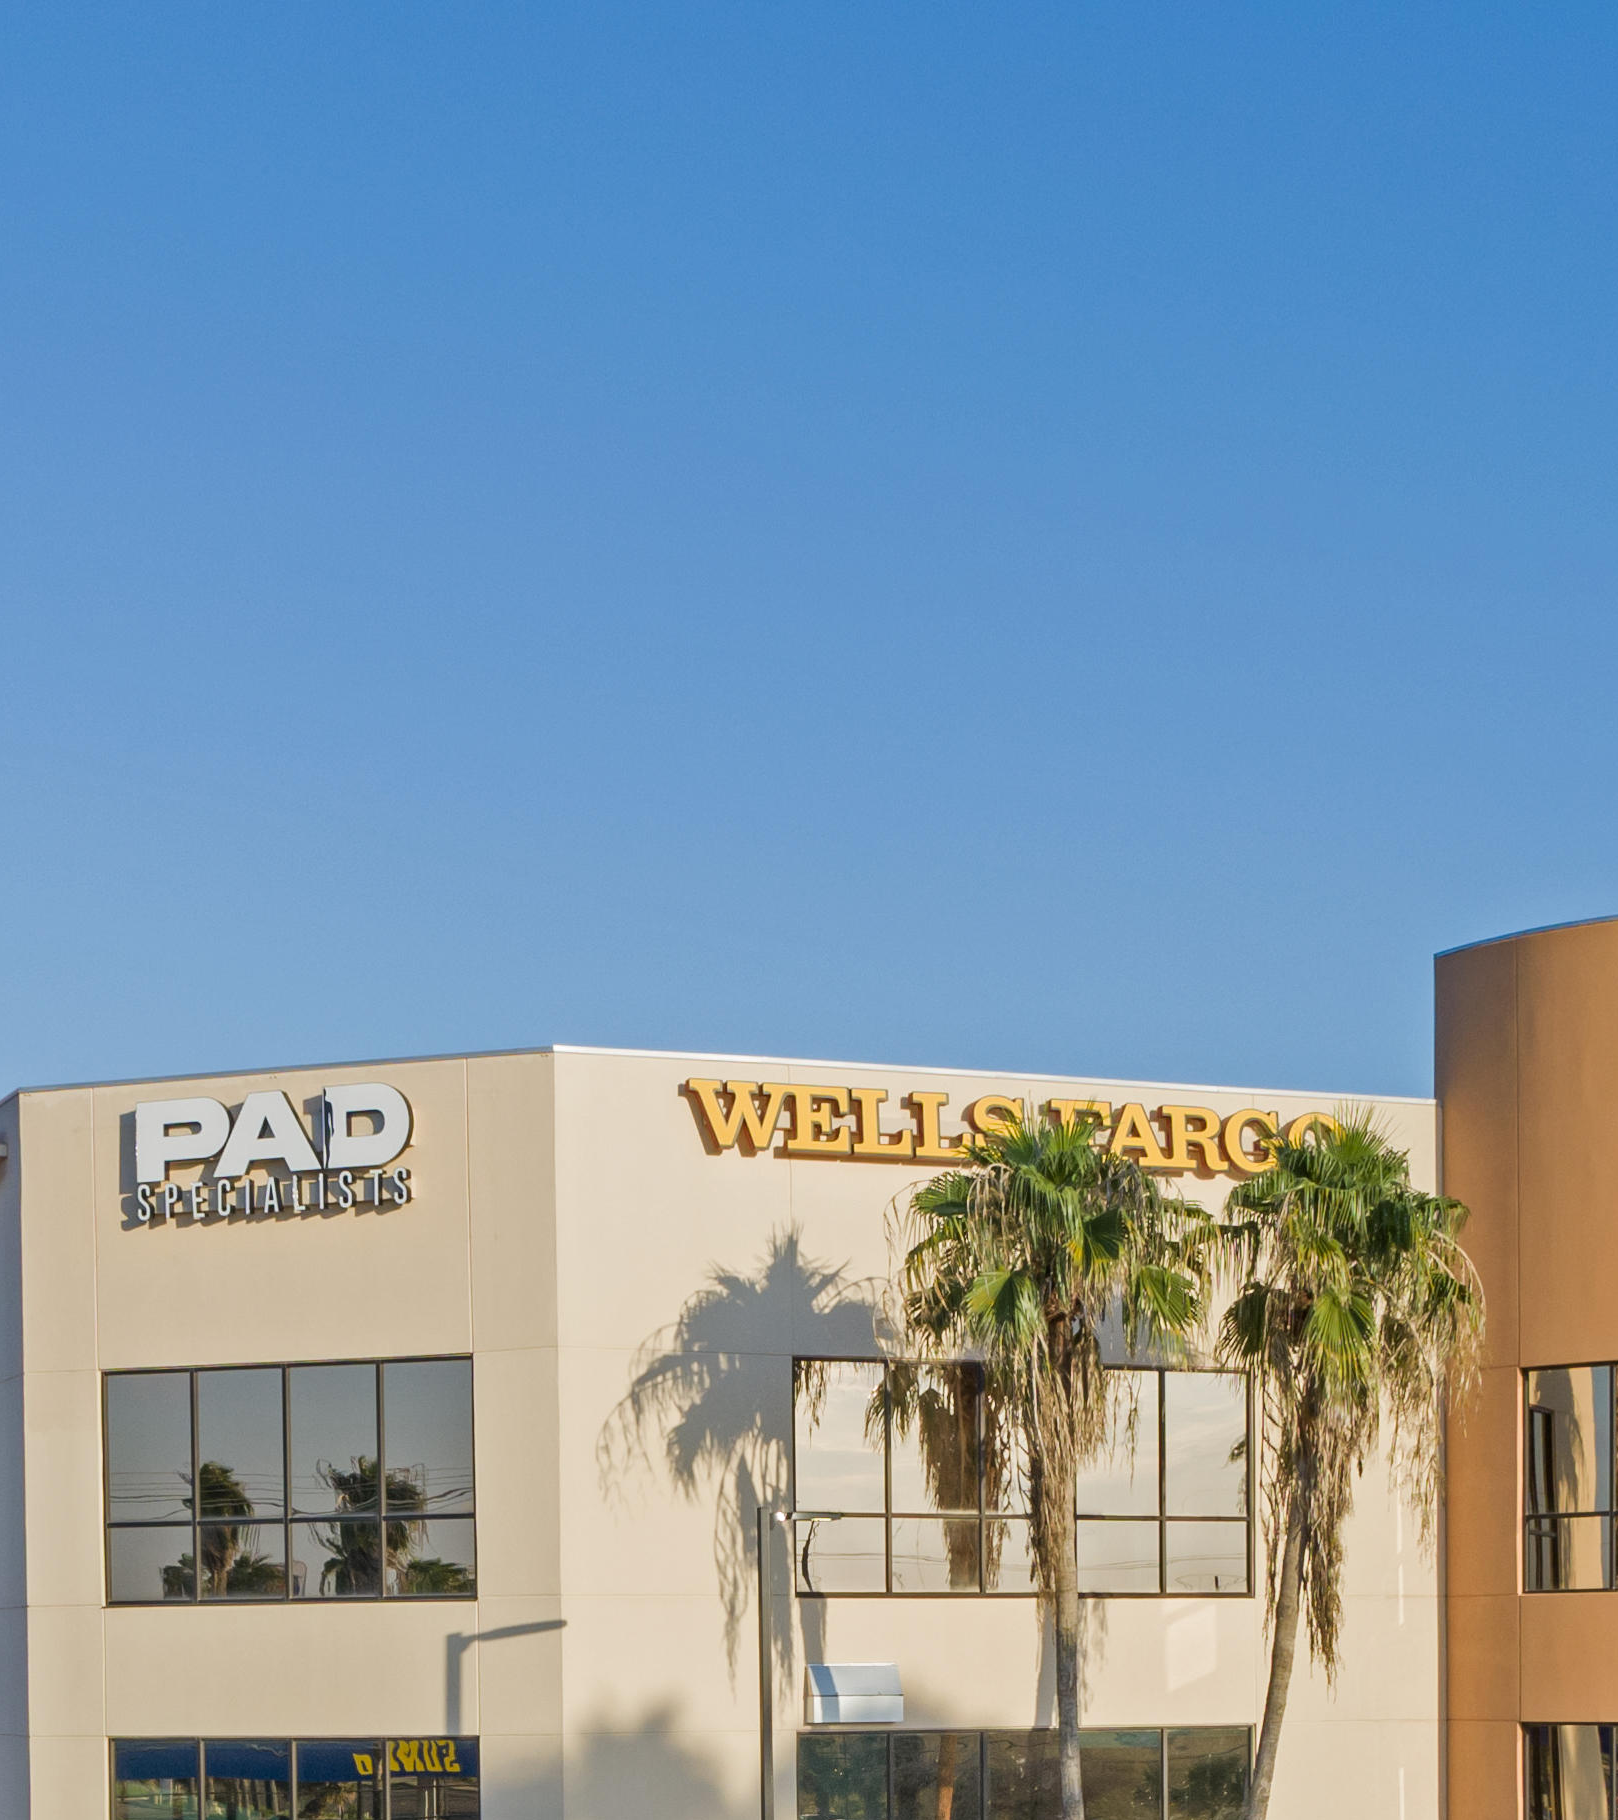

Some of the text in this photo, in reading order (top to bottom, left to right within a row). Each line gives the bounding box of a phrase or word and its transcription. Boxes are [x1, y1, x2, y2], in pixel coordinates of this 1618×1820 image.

[136, 1082, 411, 1184] PAD
[686, 1077, 1025, 1160] WELLS
[137, 1166, 409, 1222] SPECIALISTS
